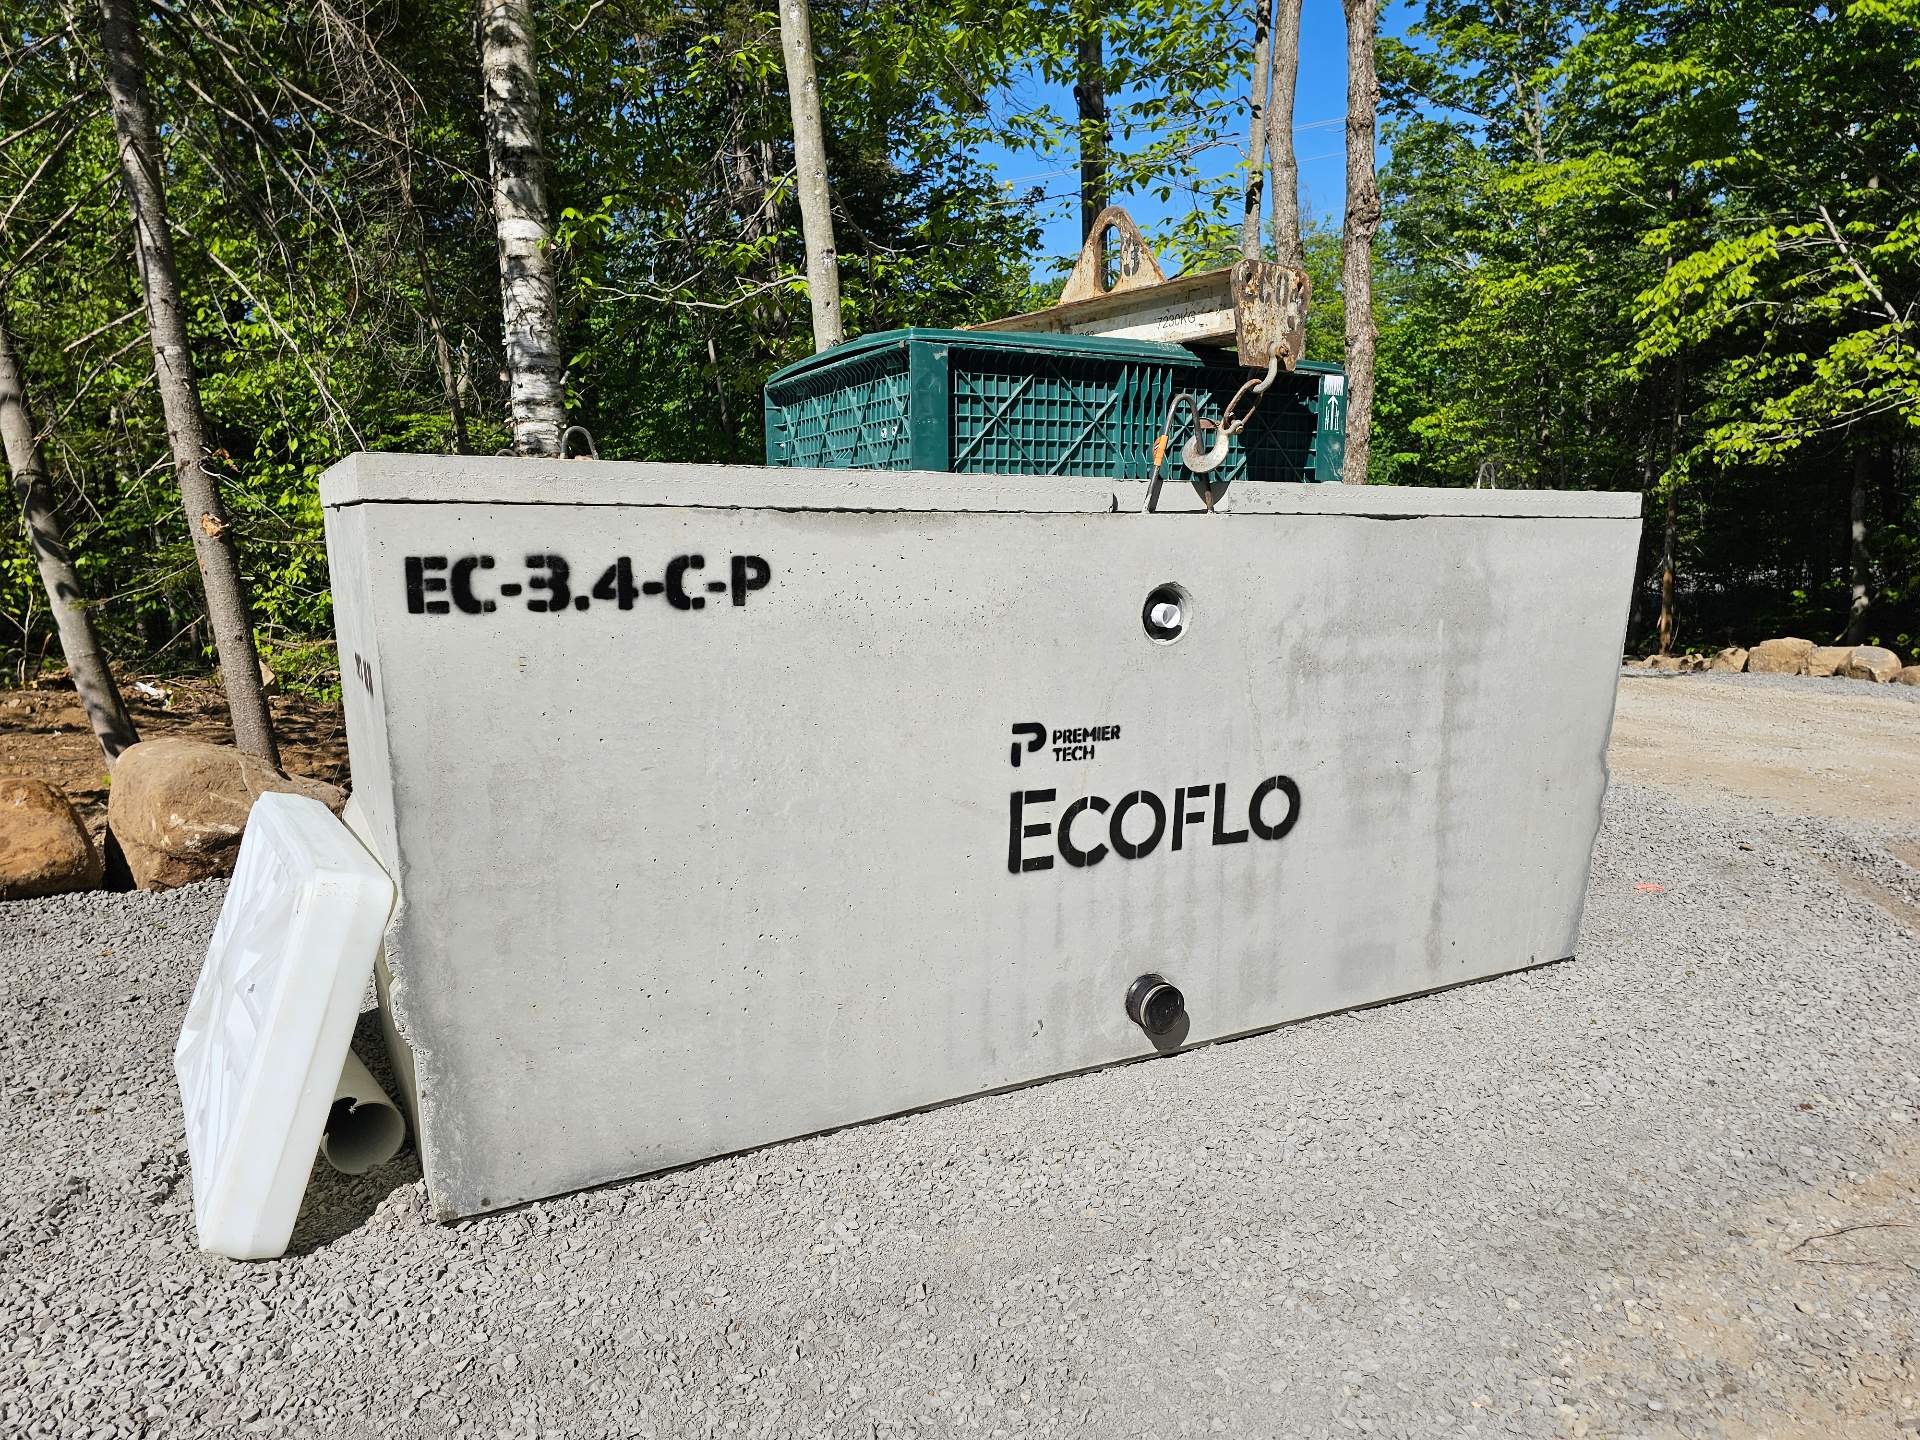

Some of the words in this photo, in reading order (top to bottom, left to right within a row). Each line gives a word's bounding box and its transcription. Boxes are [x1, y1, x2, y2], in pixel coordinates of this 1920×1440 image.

[405, 554, 771, 615] EC-3.4-C-P
[1052, 725, 1121, 745] PREMIER
[1053, 745, 1095, 762] TECH
